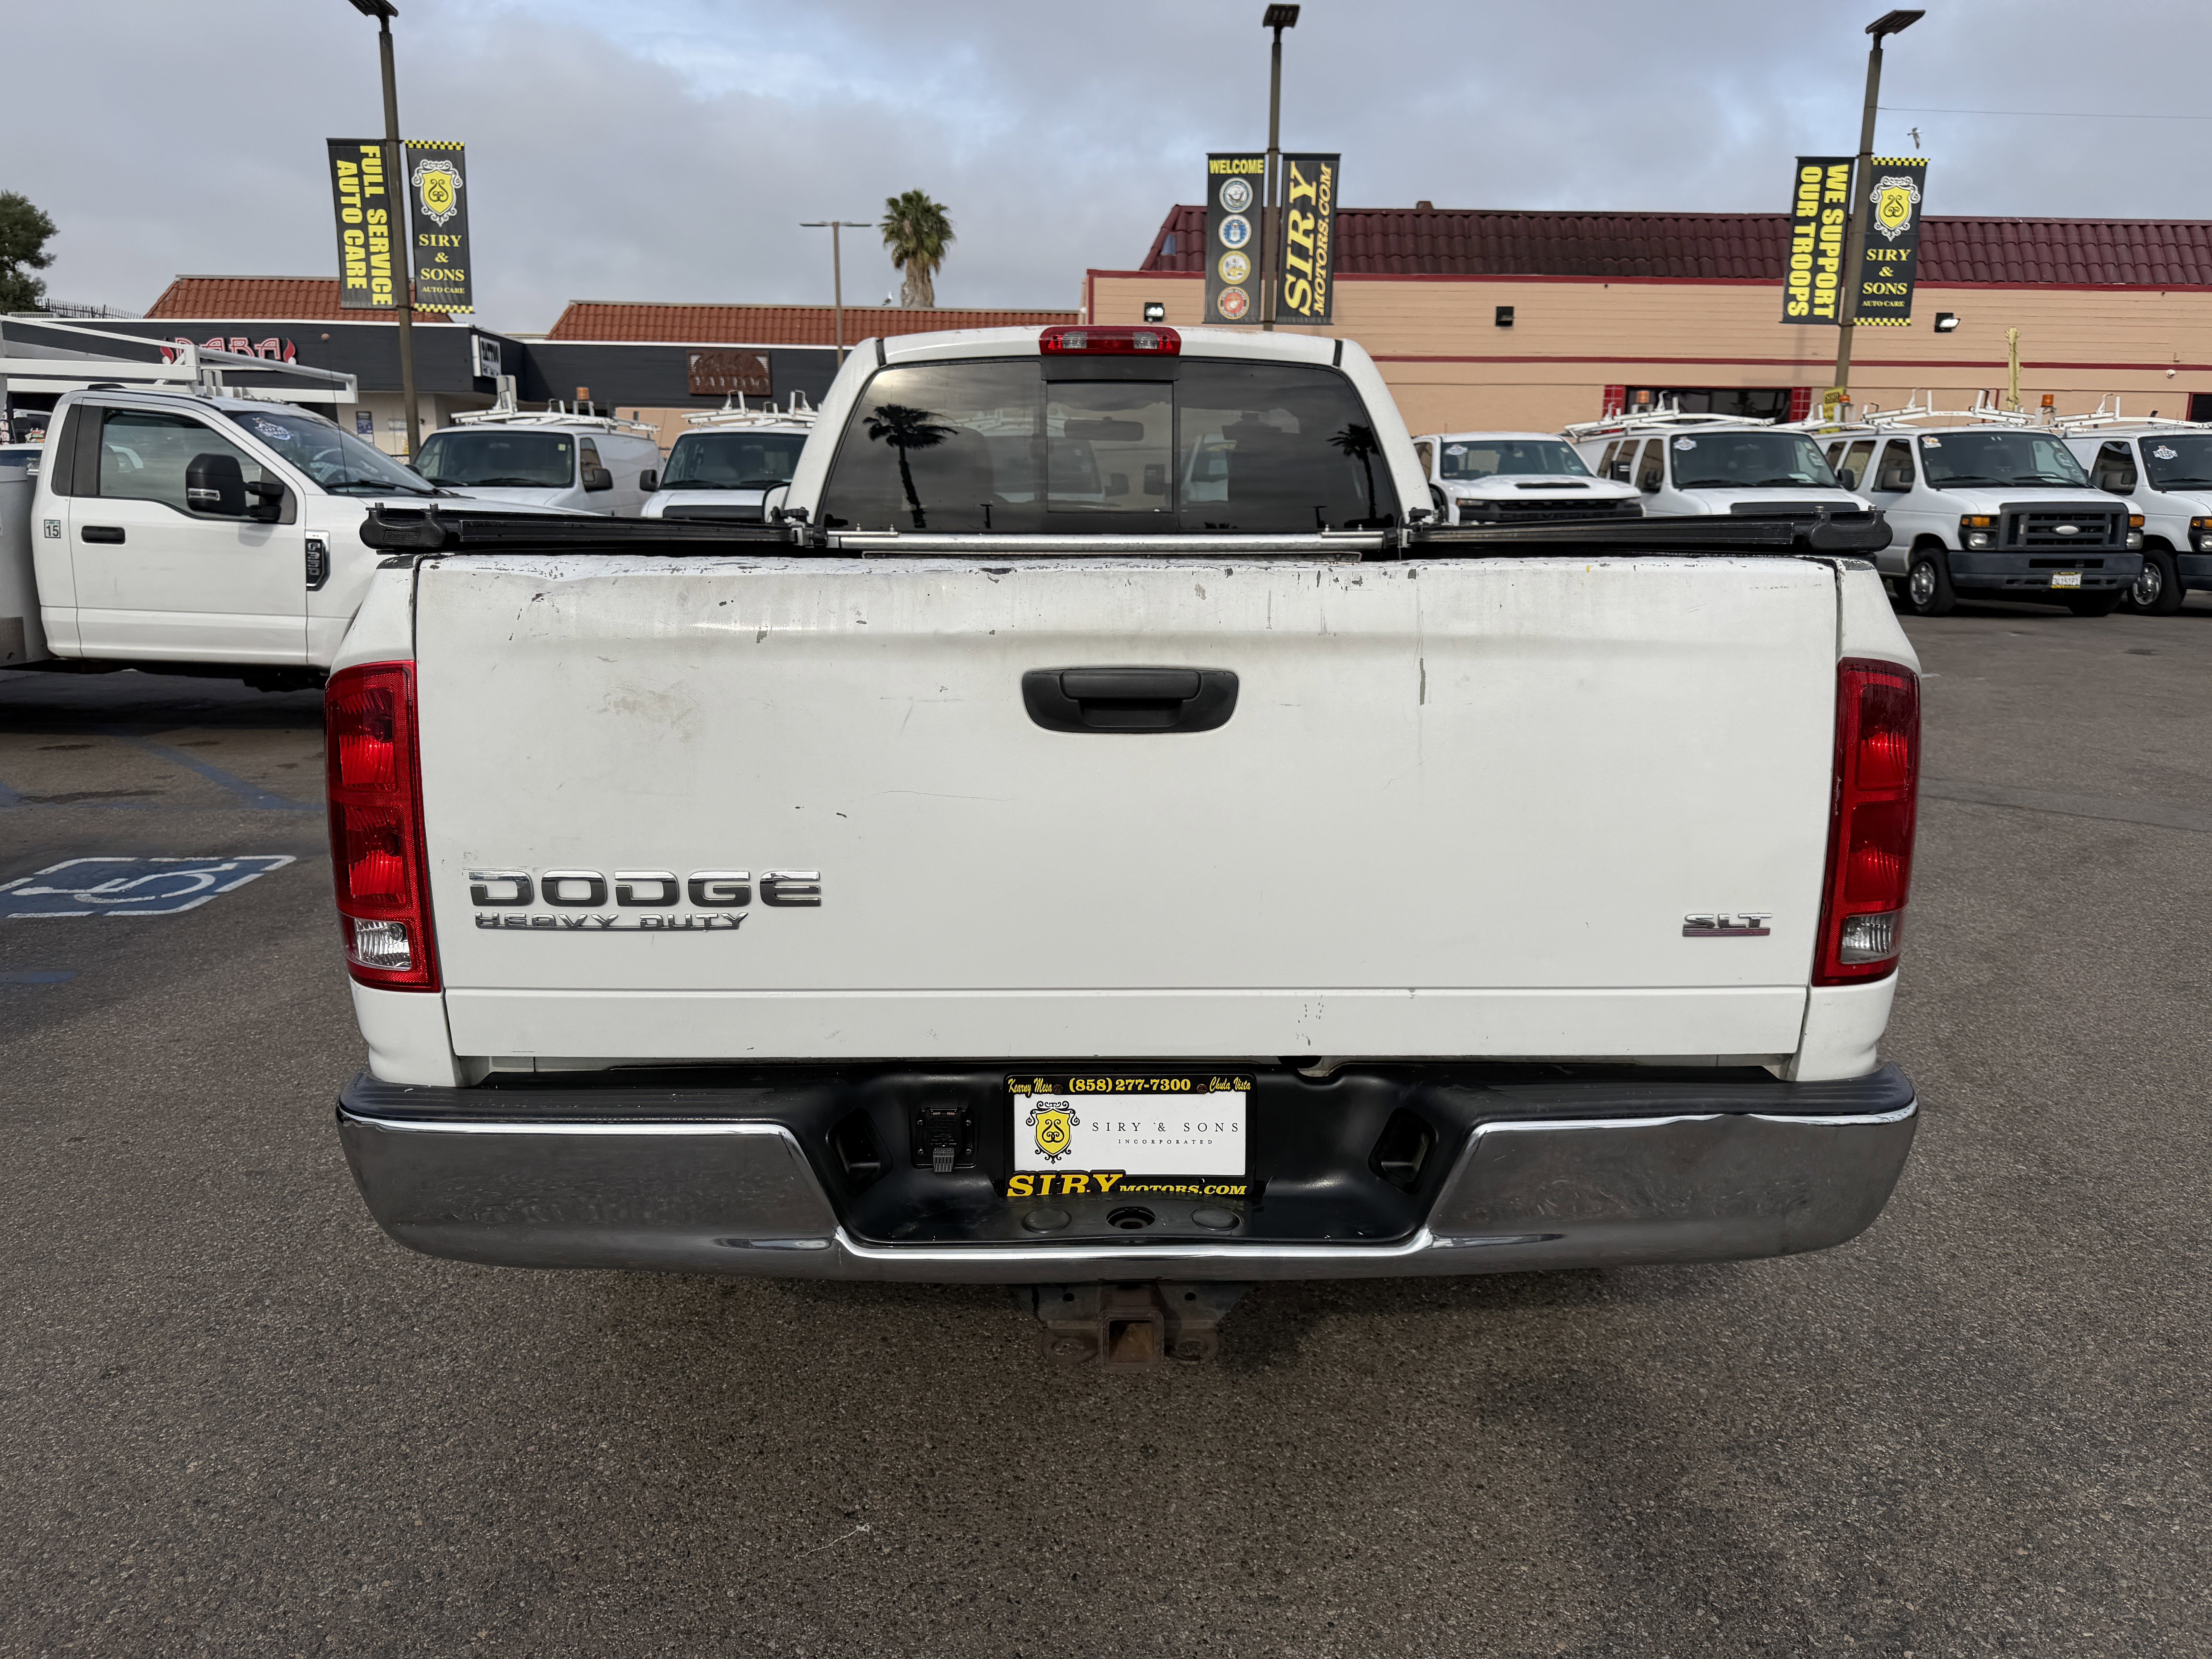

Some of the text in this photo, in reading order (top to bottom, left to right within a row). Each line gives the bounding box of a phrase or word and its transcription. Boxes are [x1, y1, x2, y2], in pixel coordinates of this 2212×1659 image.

[1209, 159, 1264, 174] WELCOME
[337, 160, 367, 289] AUTO CARE
[360, 146, 392, 305] FULL SERVICE
[419, 234, 462, 247] SIRY
[1284, 161, 1317, 316] SIRY
[1314, 162, 1332, 316] MOTORS.COM
[1787, 166, 1822, 316] OUR TROOPS
[1813, 164, 1849, 319] WE SUPPORT
[435, 252, 449, 263] &
[1866, 249, 1911, 261] SIRY
[421, 268, 465, 282] SONS
[1879, 266, 1894, 277] &
[1862, 282, 1908, 295] SONS
[46, 525, 59, 536] 15
[469, 870, 822, 907] DODGE
[475, 911, 749, 929] HEAVY DUTY
[1683, 913, 1772, 929] SLT
[1008, 1077, 1053, 1096] Kearny Mesa
[1069, 1078, 1191, 1092] (858) 277-7300
[1209, 1076, 1251, 1091] Chula Vista
[1092, 1122, 1239, 1132] SIRY & SONS
[1006, 1174, 1123, 1197] SIRY
